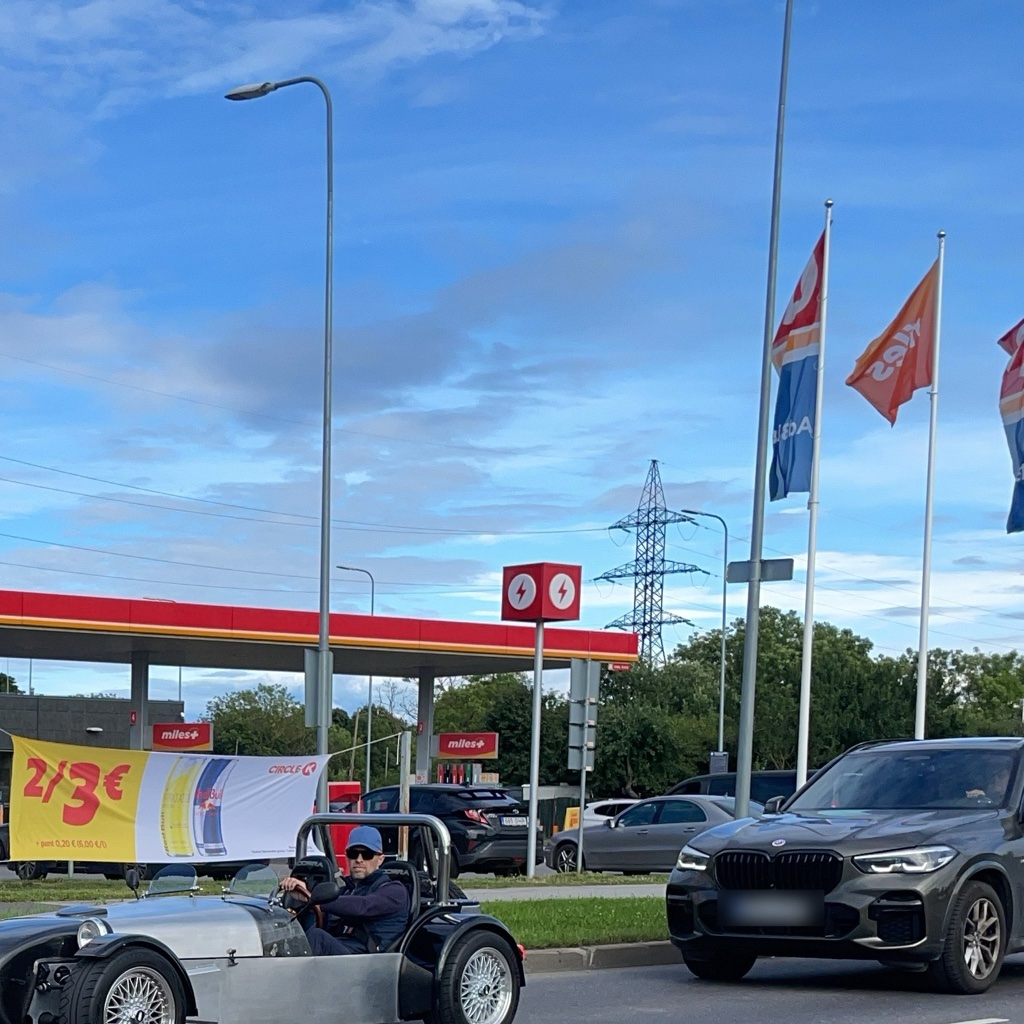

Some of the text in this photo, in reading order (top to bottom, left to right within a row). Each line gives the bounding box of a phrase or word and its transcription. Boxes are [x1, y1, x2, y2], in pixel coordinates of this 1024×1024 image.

[161, 729, 199, 739] miles+
[448, 739, 485, 748] miles+
[269, 762, 317, 776] CIRCLE K
